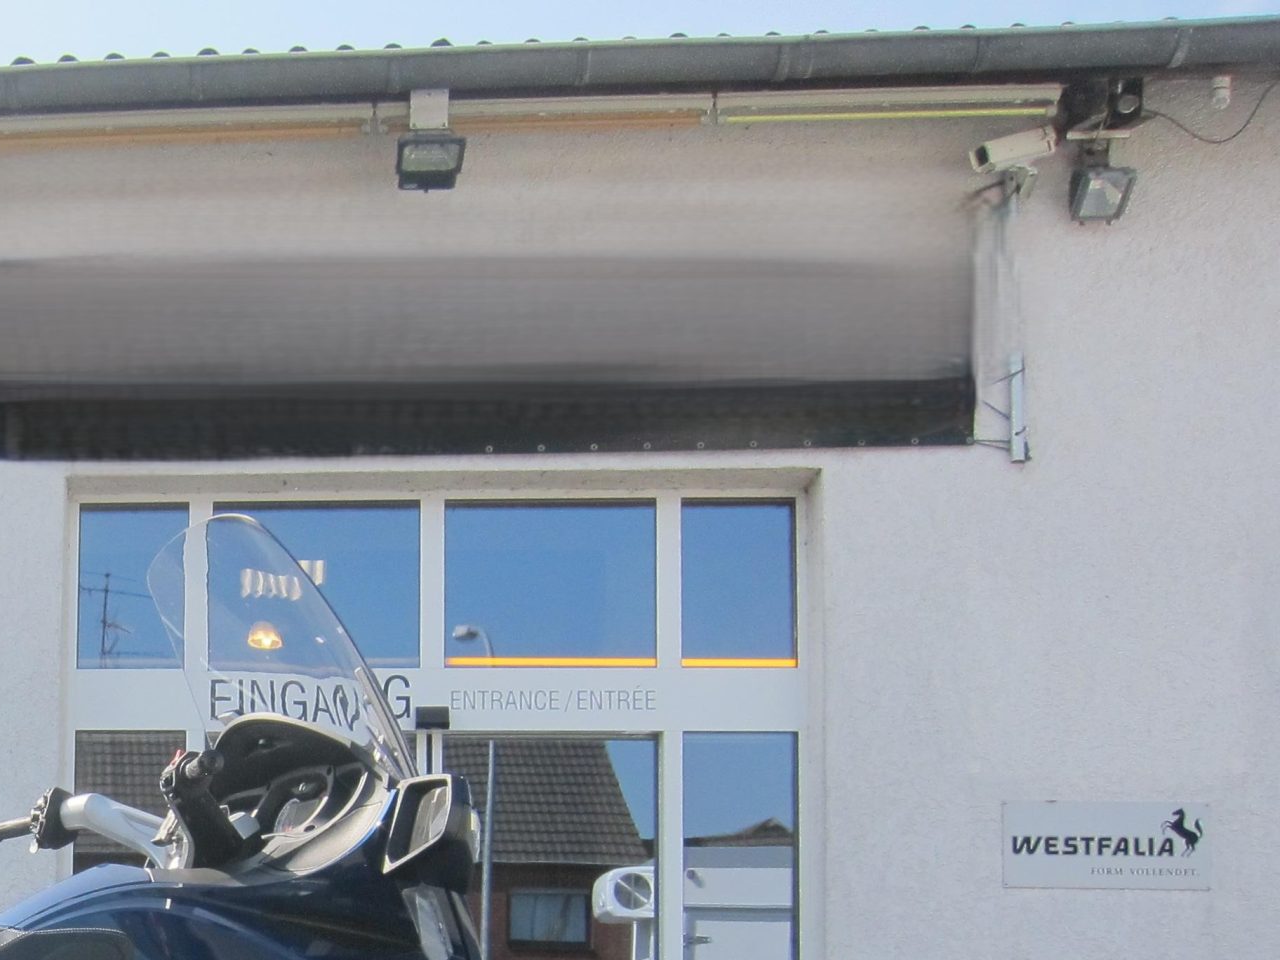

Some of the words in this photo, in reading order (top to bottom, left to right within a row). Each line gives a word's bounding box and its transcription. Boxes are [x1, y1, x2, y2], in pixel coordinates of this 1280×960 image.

[450, 689, 560, 711] ENTRANCE
[577, 685, 657, 711] ENTRÉE
[1012, 835, 1175, 857] WESTFALIA
[1090, 867, 1124, 876] FORM
